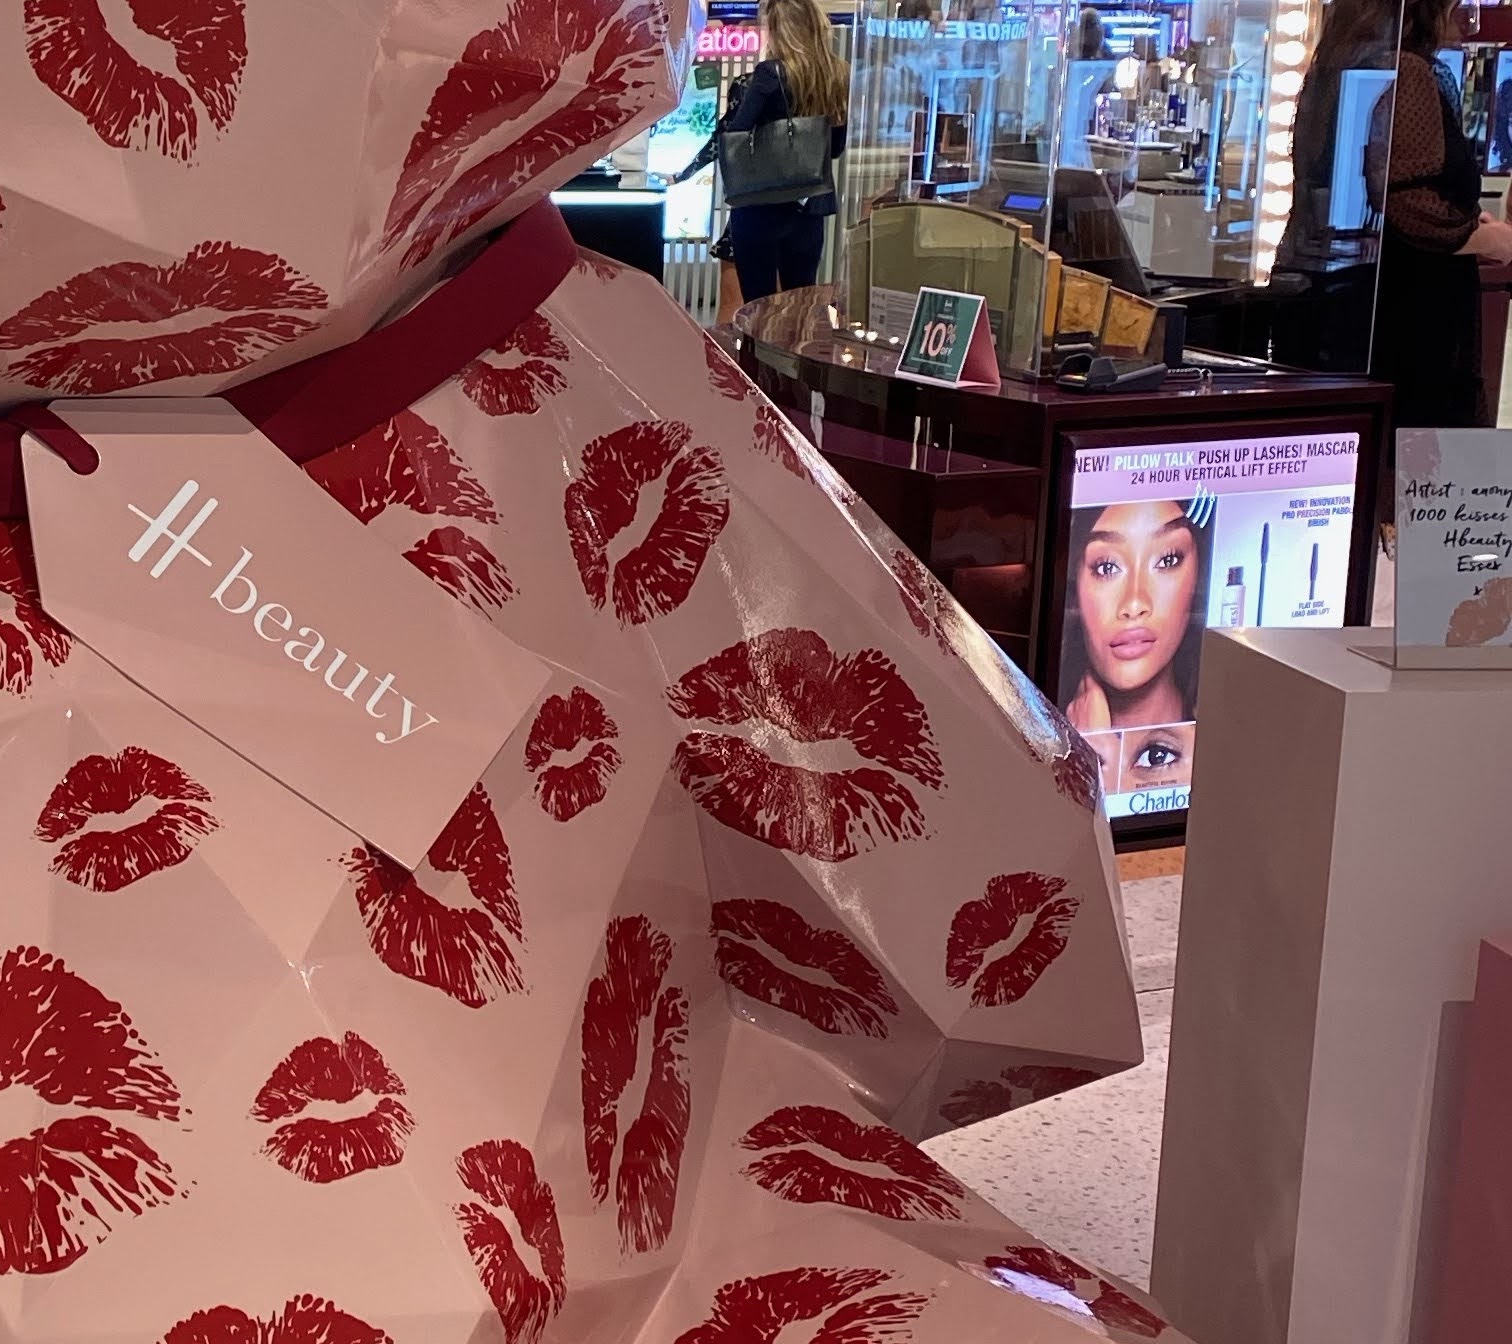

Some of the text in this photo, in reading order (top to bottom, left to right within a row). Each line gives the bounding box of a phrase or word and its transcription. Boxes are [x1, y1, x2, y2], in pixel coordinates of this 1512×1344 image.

[698, 27, 760, 52] ation
[1075, 440, 1358, 473] NEW! PILLOW TALK PUSH UP LASHES! MASCAR
[1131, 459, 1308, 485] 24 HOUR VERTICAL LIFT EFFECT
[1405, 479, 1456, 498] Artist
[1410, 503, 1509, 522] 1000 kisses
[209, 545, 439, 744] beauty
